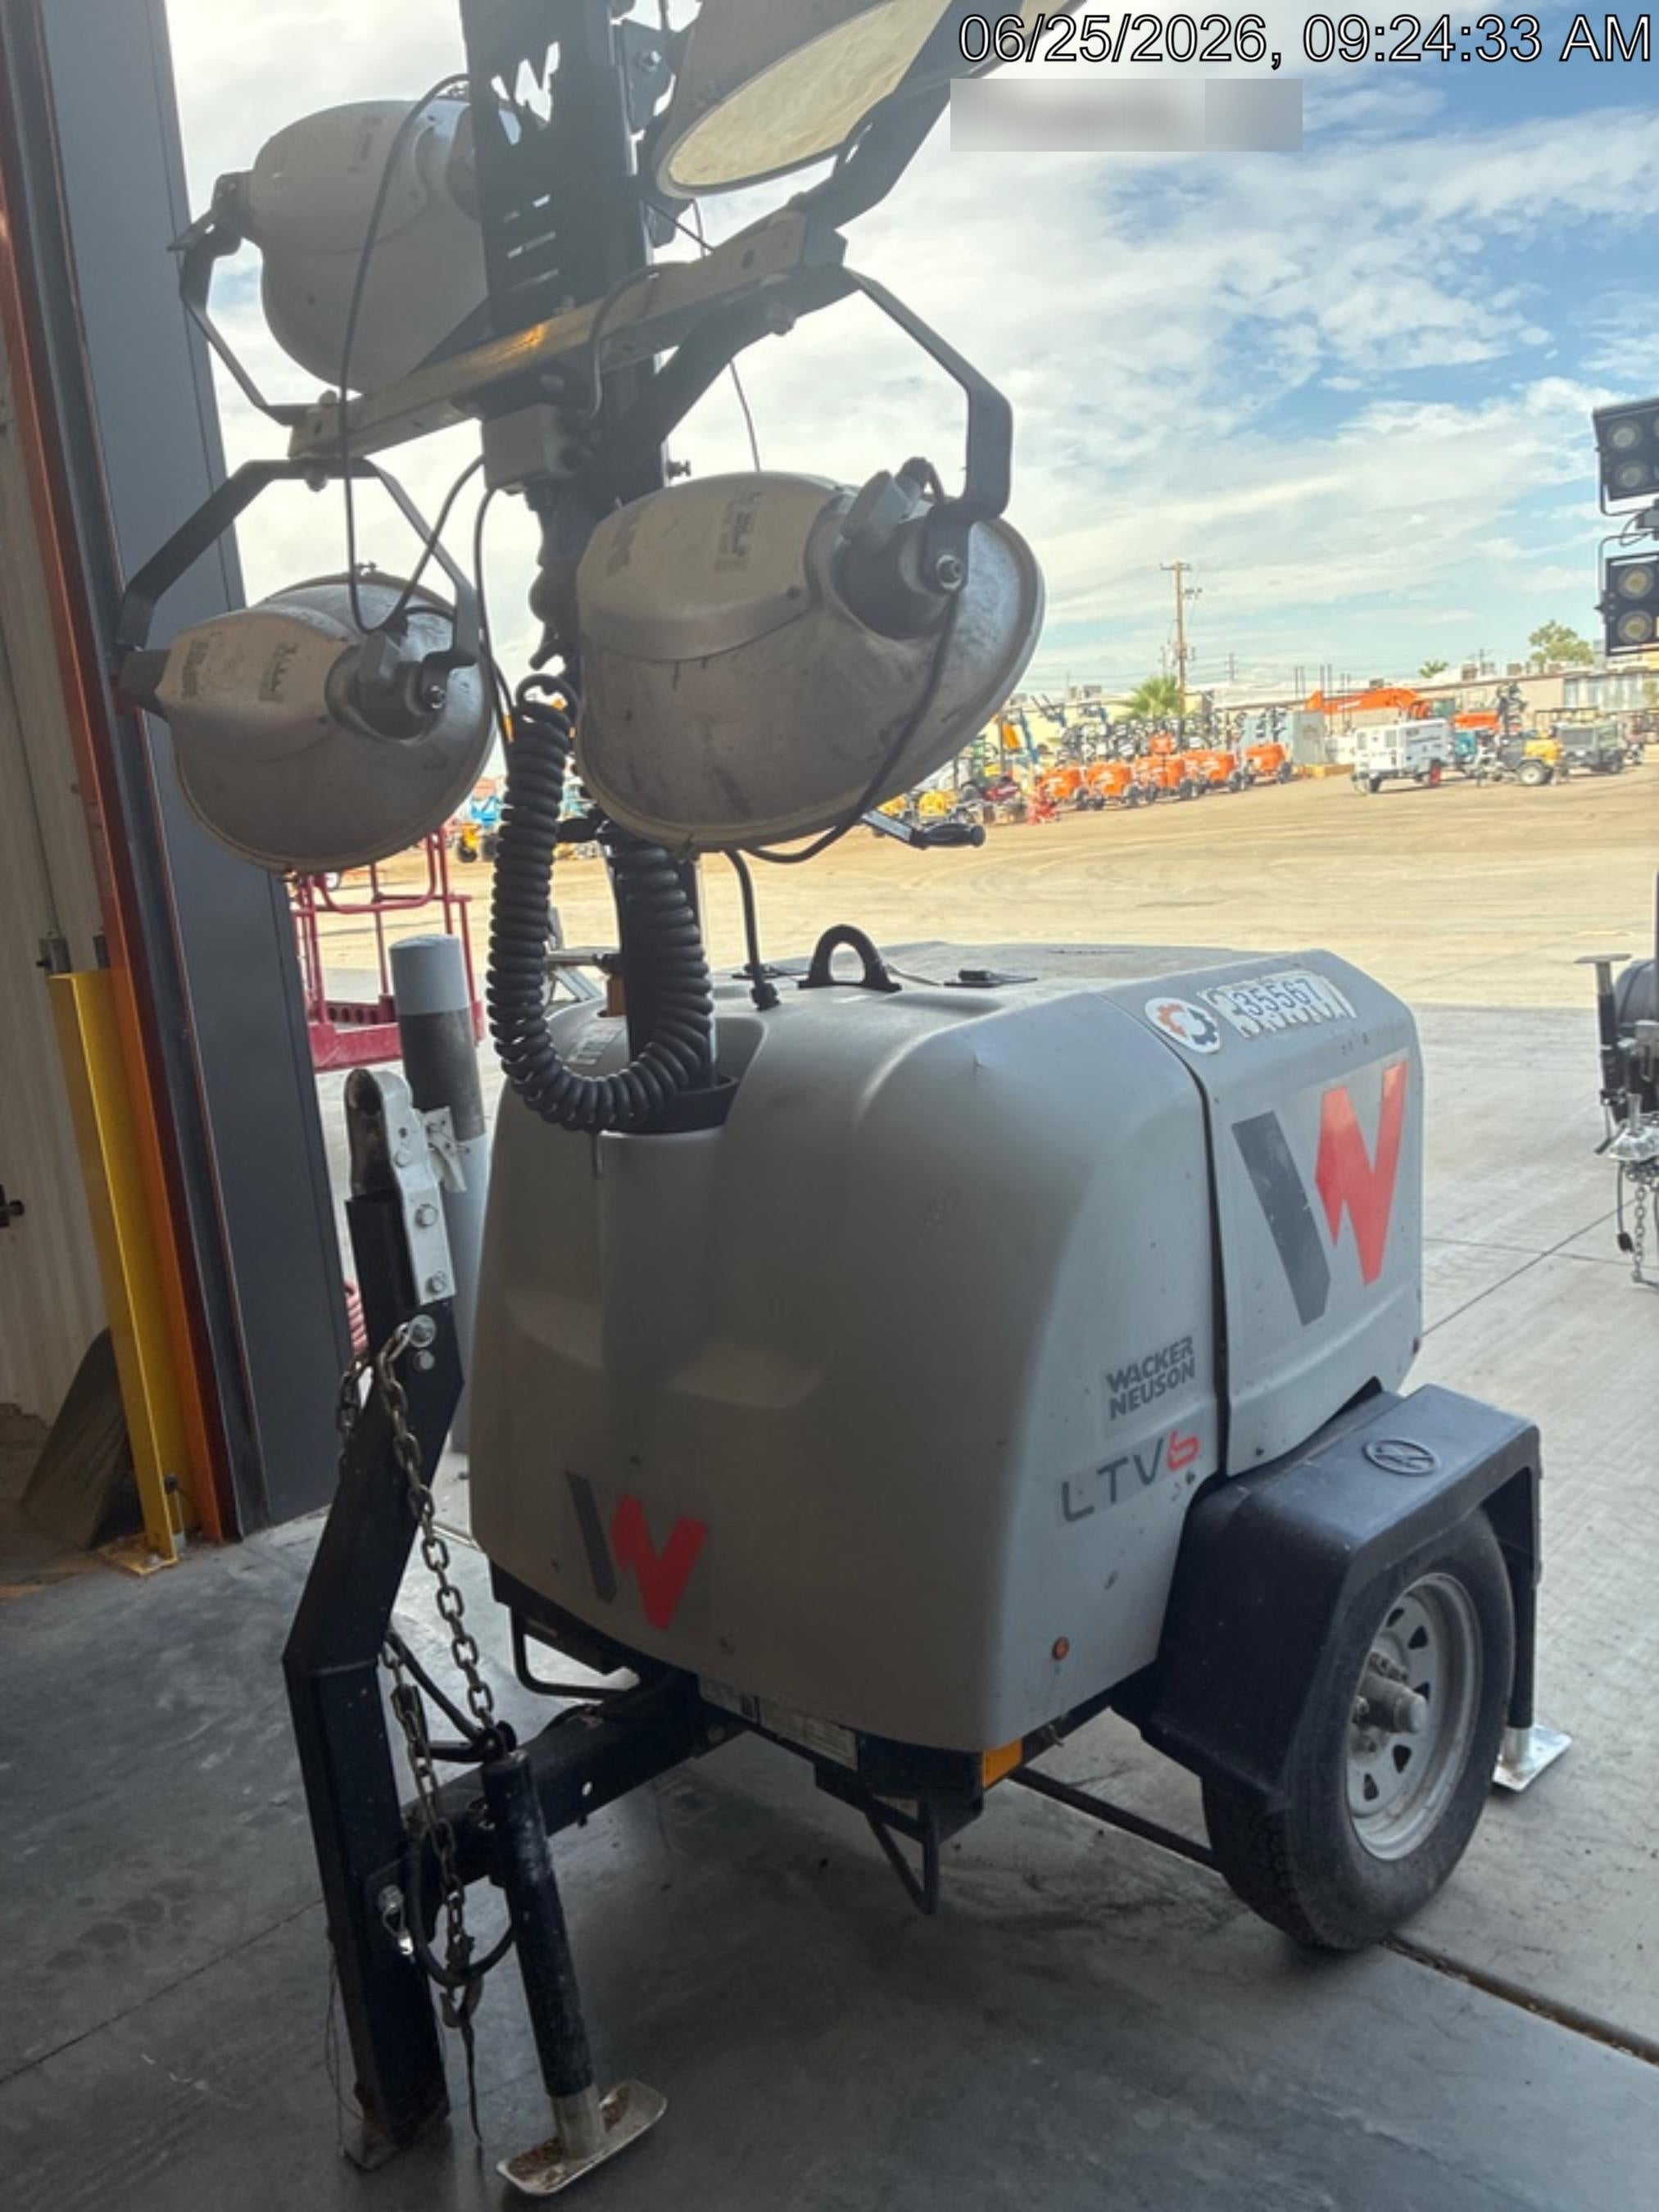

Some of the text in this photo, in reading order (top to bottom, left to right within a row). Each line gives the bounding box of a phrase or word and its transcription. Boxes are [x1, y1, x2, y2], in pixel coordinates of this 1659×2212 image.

[1105, 1335, 1194, 1394] WACKER
[1108, 1356, 1196, 1421] NEUSON
[1060, 1430, 1201, 1522] LTV6
